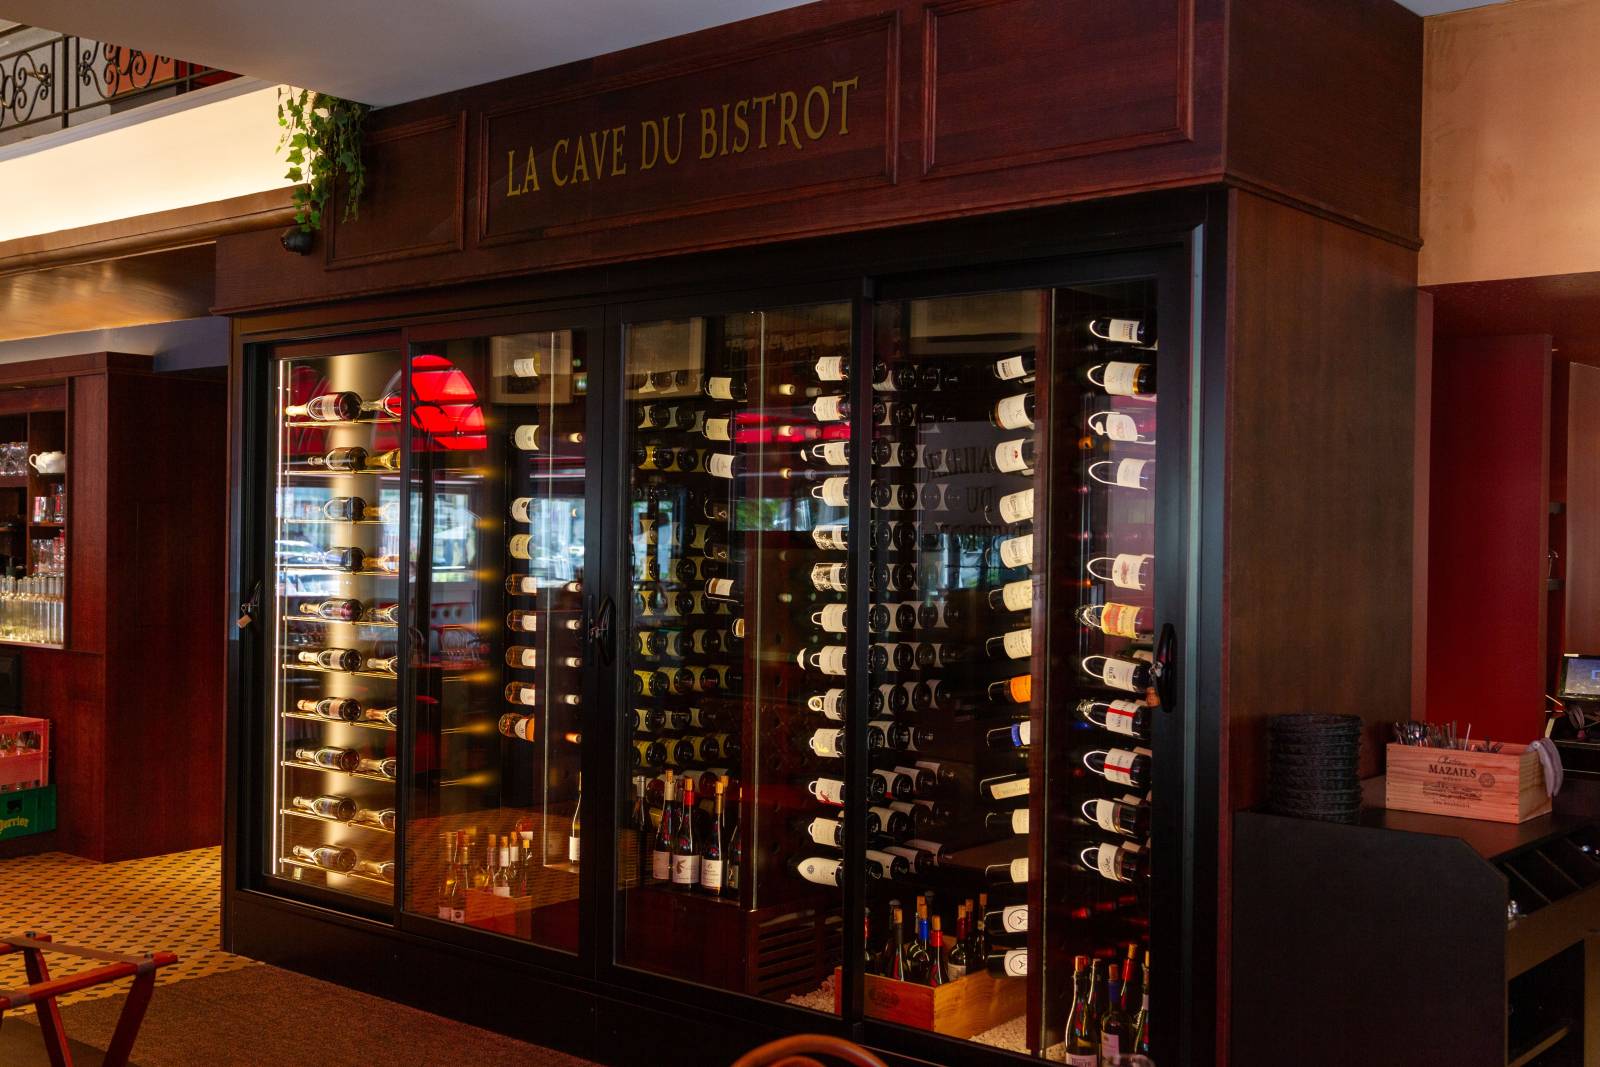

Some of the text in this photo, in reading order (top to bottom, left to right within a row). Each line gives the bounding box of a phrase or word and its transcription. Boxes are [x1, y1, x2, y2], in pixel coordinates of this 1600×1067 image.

[506, 76, 859, 197] LA CAVE DU BISTROT
[1429, 764, 1478, 779] MAZAILS
